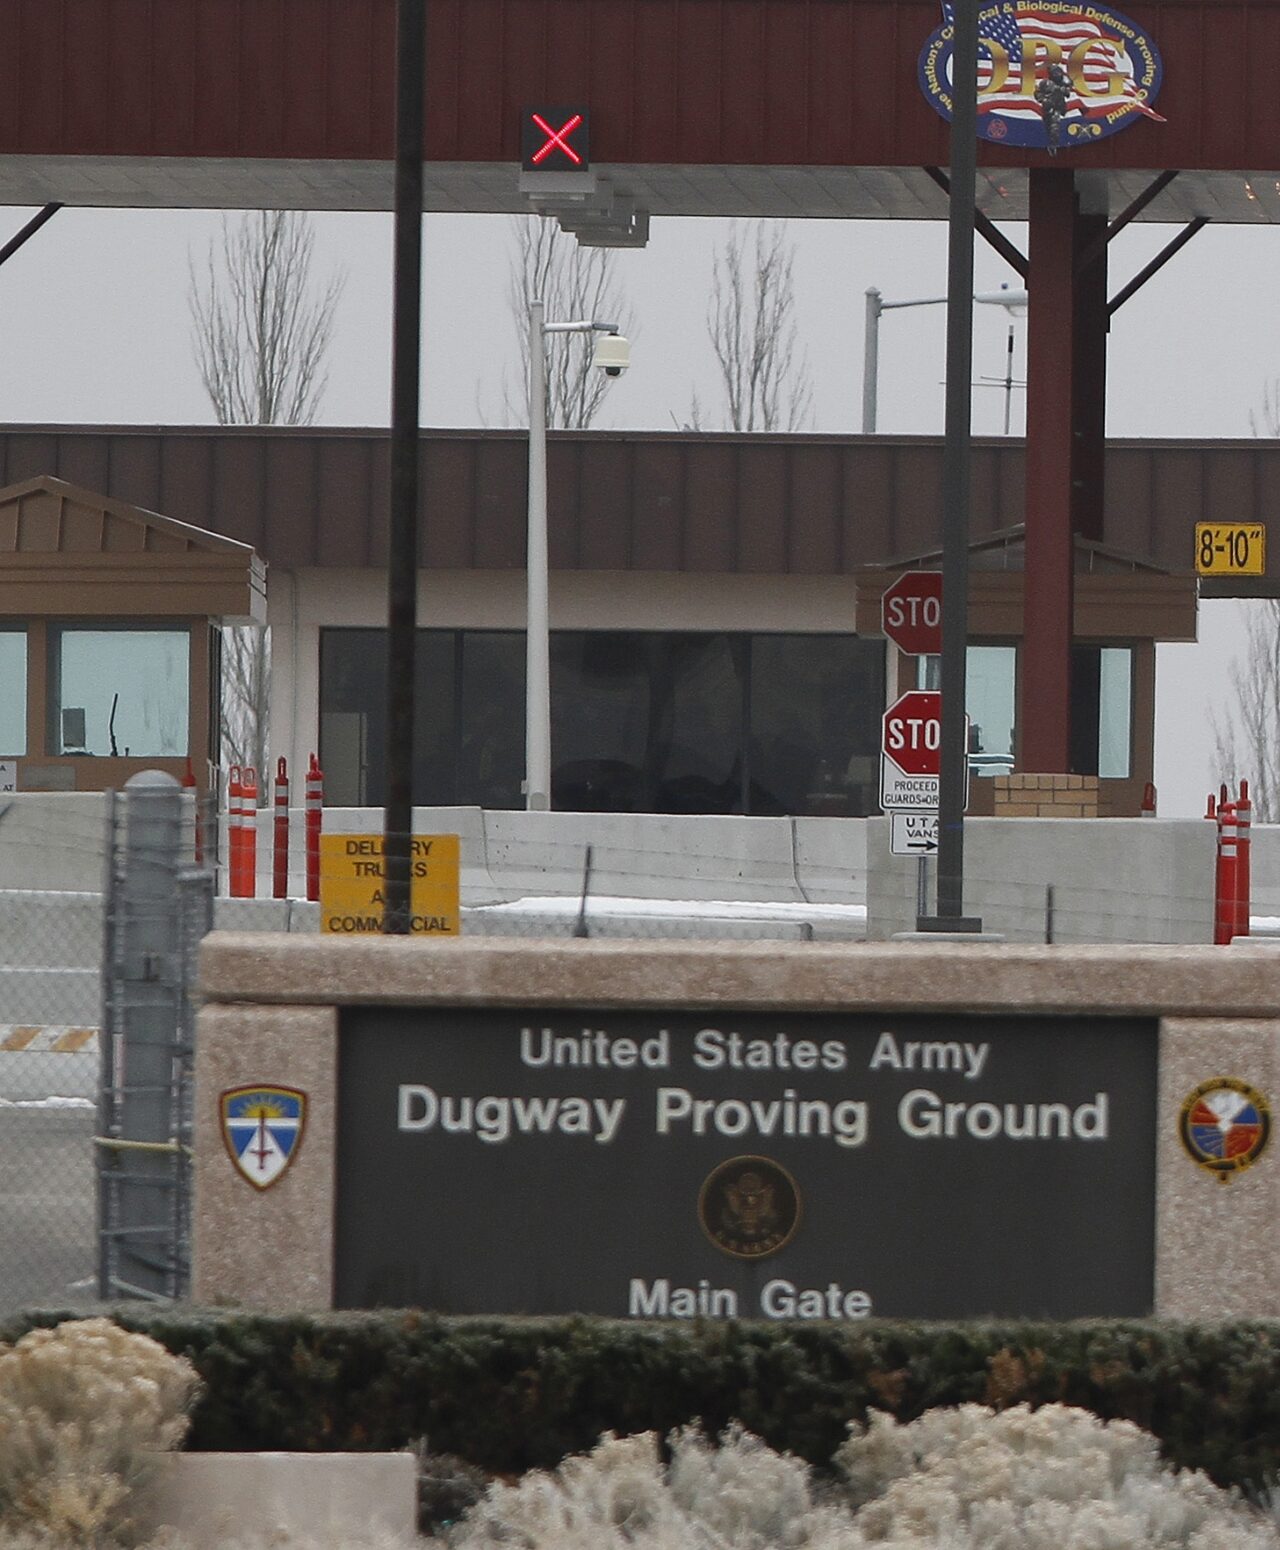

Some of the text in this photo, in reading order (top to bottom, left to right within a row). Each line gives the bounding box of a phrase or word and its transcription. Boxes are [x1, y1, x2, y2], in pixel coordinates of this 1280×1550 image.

[1003, 3, 1013, 13] &
[1016, 0, 1083, 15] Biological
[1085, 7, 1135, 39] Defense
[1134, 36, 1156, 86] Proving
[1106, 88, 1148, 124] Gound
[887, 597, 940, 627] STO
[888, 718, 940, 750] STO
[894, 781, 937, 791] PROCEED
[346, 840, 433, 855] DELRY
[906, 829, 939, 838] VANS
[352, 861, 427, 877] TRUS
[329, 916, 451, 932] COMMCIAL
[520, 1027, 990, 1079] United States Army
[398, 1084, 1109, 1147] Dugway Proving Ground
[629, 1278, 873, 1319] Main Gate
